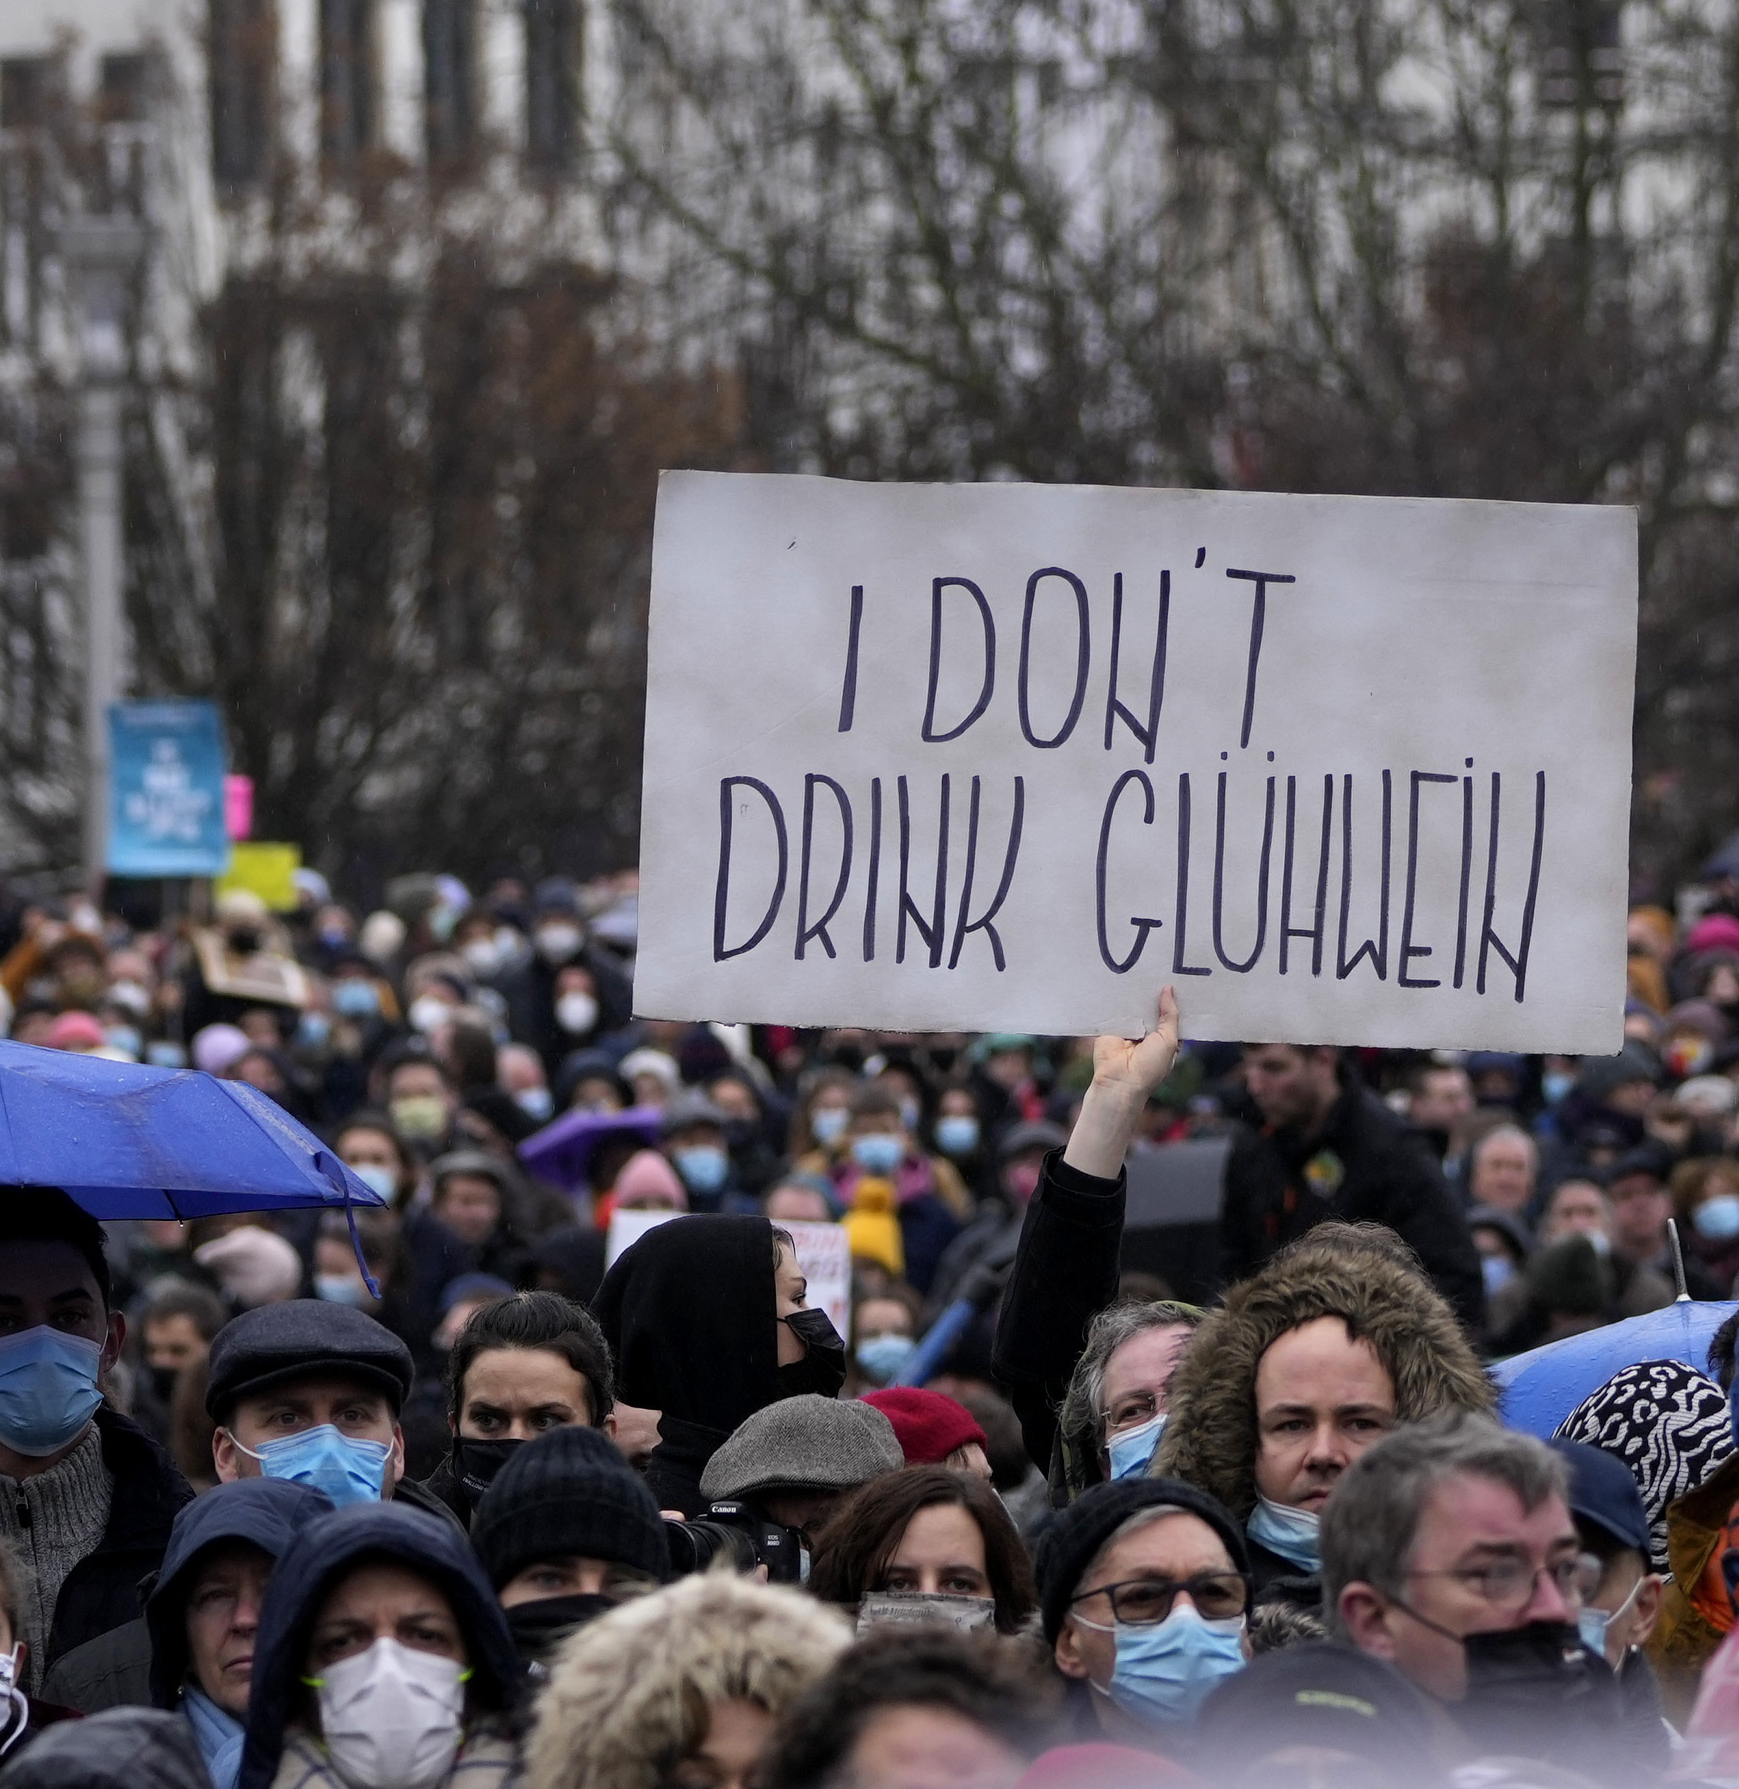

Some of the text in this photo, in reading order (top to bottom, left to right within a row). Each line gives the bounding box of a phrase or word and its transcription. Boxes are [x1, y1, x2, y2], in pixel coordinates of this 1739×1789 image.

[837, 546, 1297, 764] I DON'T
[713, 751, 1547, 1003] DRINK GLÜHWEIN
[711, 1505, 737, 1514] Canon
